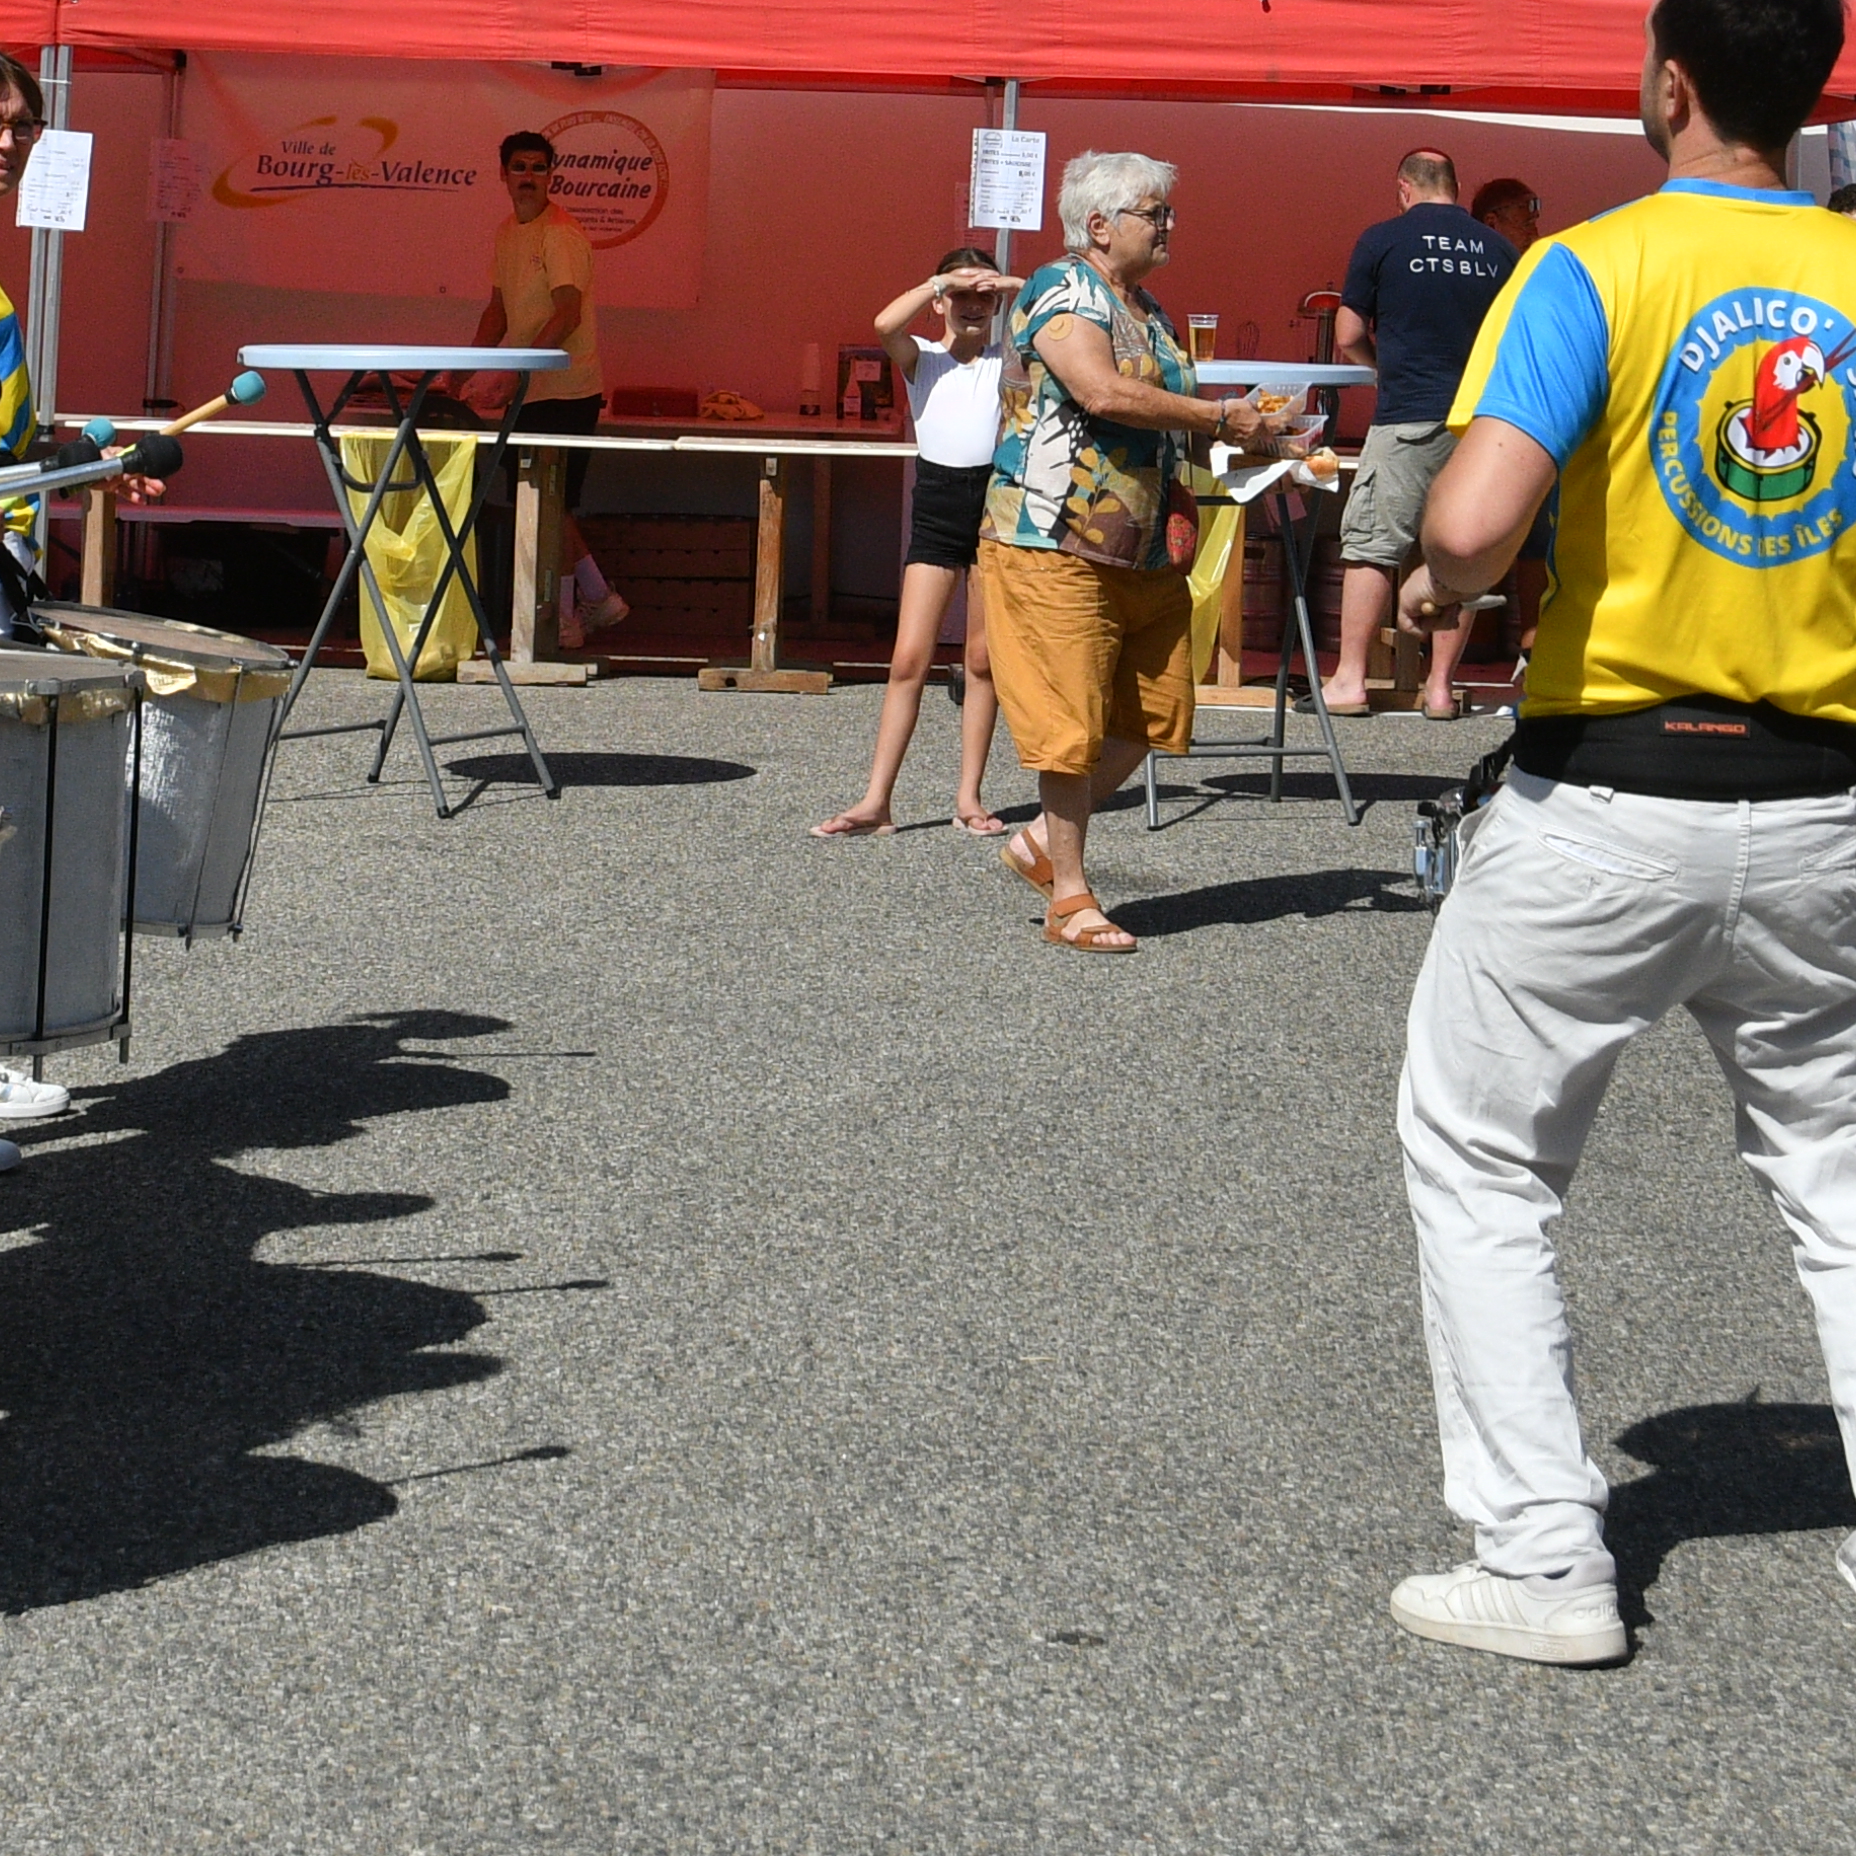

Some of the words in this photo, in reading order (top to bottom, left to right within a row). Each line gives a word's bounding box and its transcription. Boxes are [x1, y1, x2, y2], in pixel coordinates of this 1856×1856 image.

[281, 140, 315, 156] Ville
[319, 141, 336, 156] de
[256, 154, 477, 187] Bourg-lès-Valence
[552, 149, 653, 175] ynamique
[548, 175, 652, 199] Bourcaine
[1421, 235, 1484, 255] TEAM
[1678, 296, 1835, 373] DJALICO'
[1663, 721, 1747, 734] KALANGO
